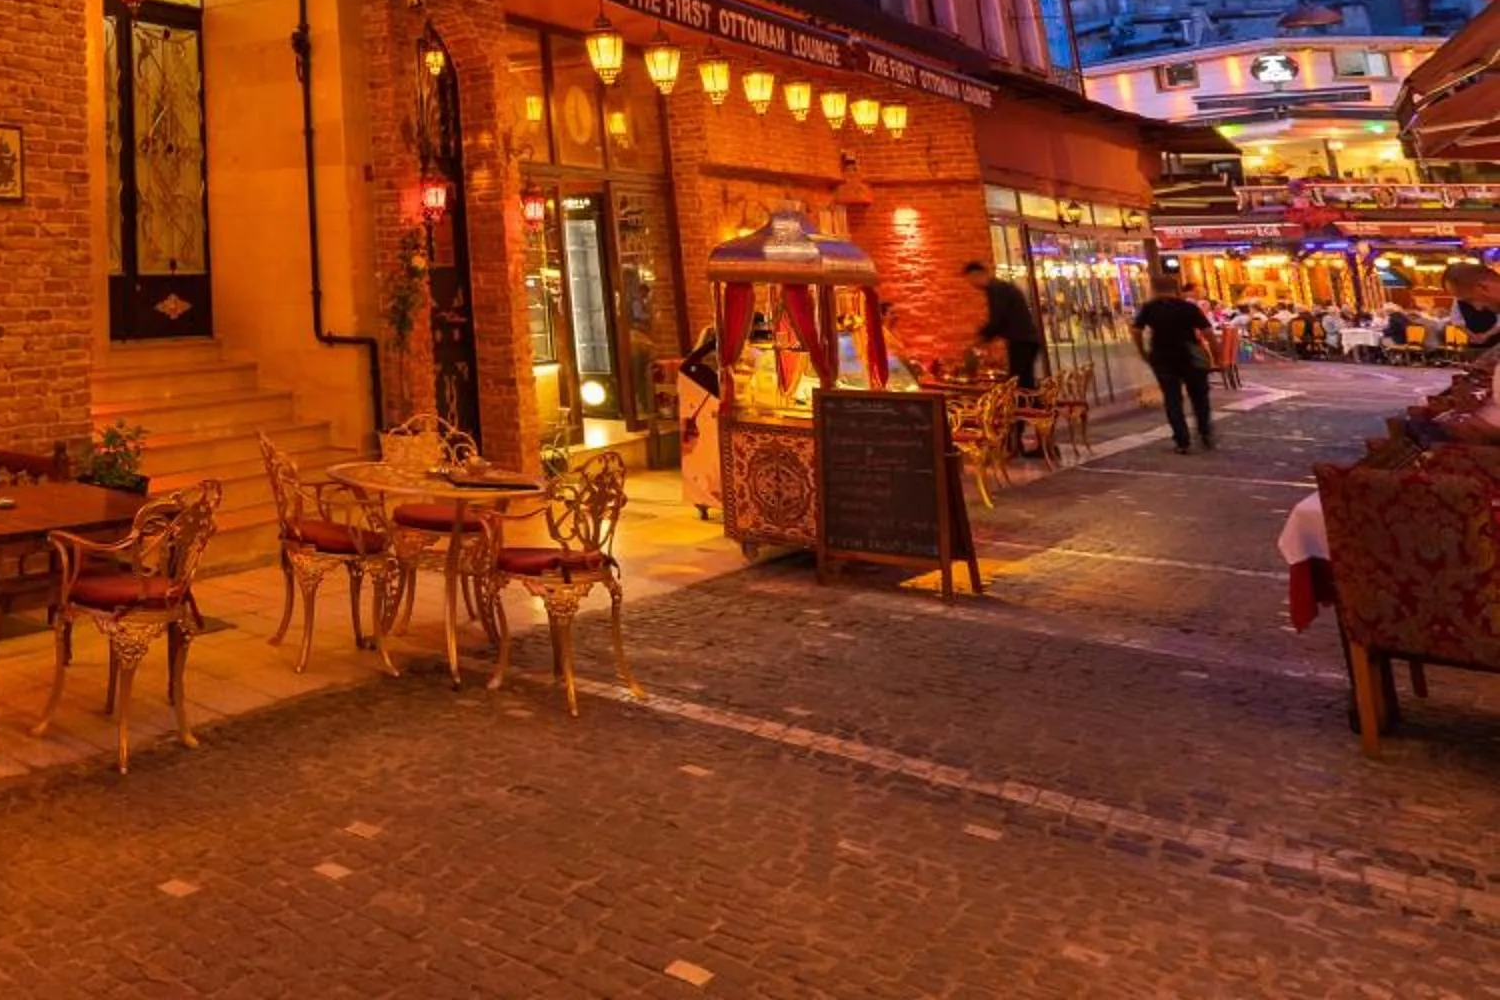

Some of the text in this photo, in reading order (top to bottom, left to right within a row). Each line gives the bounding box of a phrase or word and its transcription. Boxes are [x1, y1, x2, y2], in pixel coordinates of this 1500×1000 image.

[719, 7, 786, 51] OTTOMAN
[791, 31, 842, 67] LOUNGE
[867, 51, 889, 77] THE
[889, 58, 916, 86] FIRST
